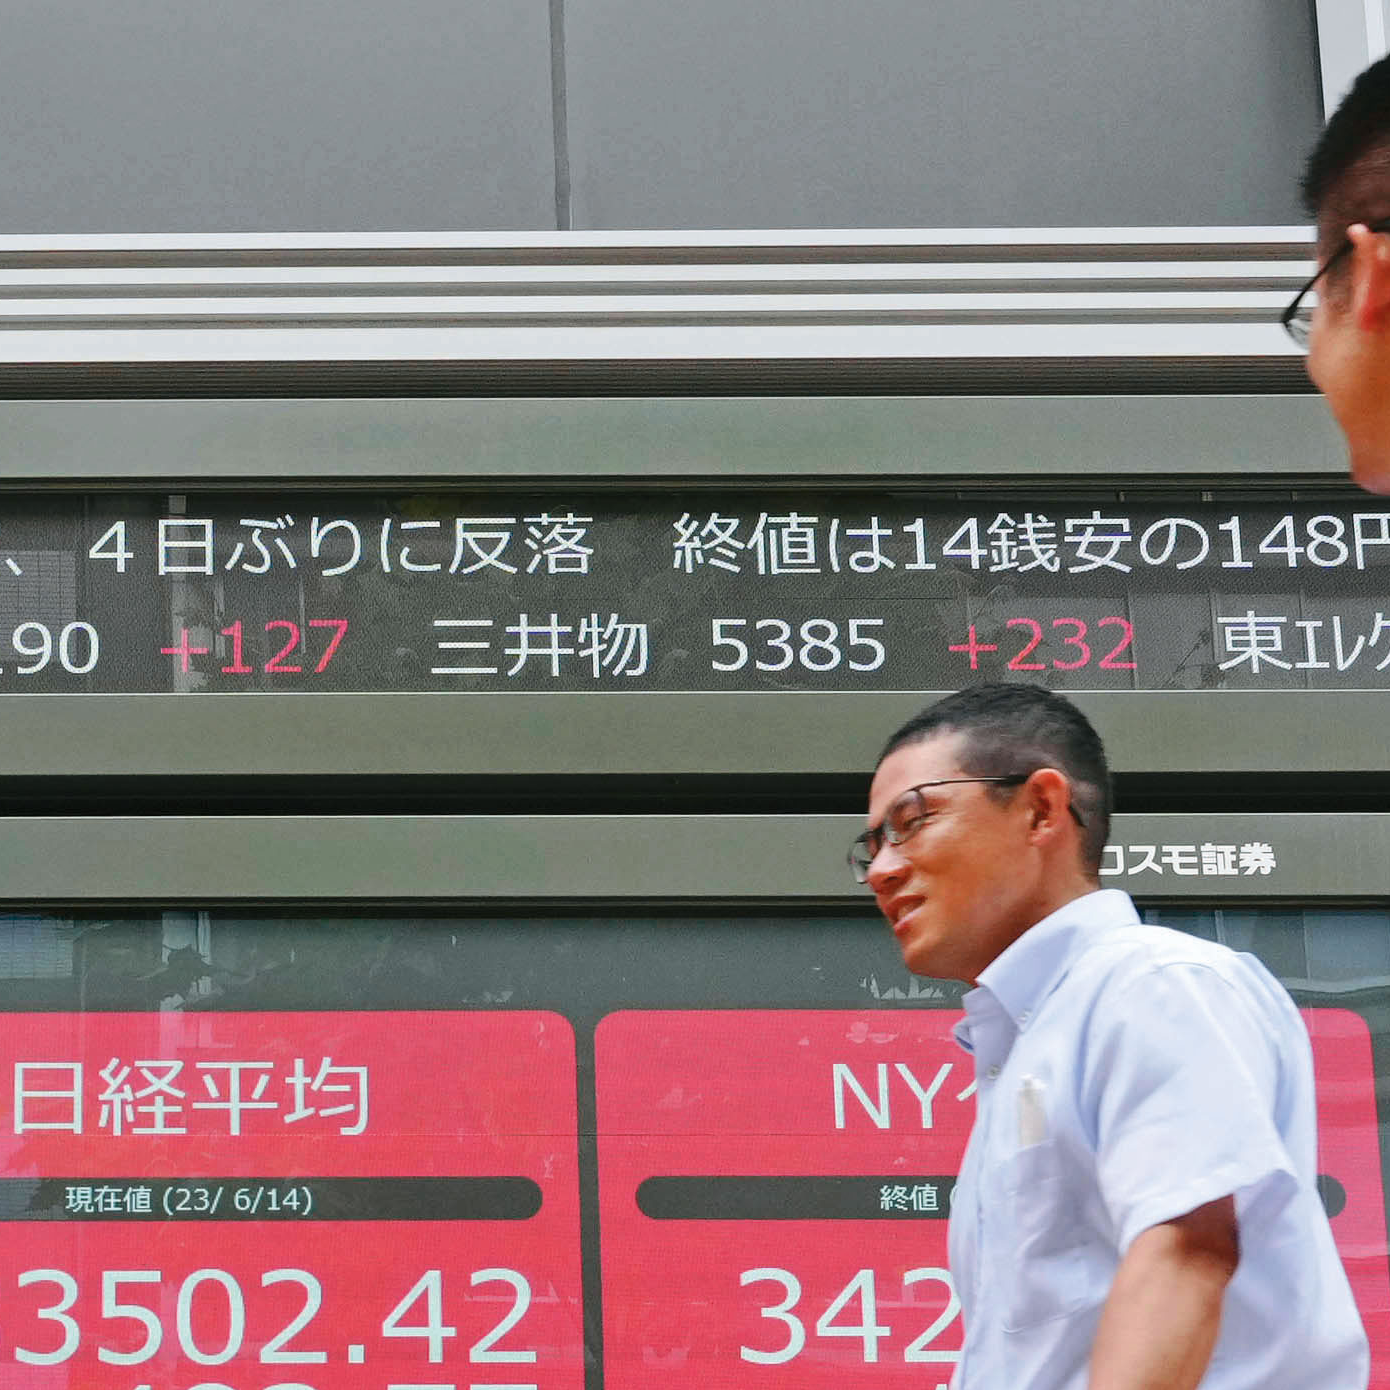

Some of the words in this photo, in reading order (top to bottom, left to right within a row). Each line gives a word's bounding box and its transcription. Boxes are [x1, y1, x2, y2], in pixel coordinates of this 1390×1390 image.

[160, 619, 348, 673] +127
[430, 612, 648, 679] 三井物
[711, 618, 885, 672] 5385
[948, 616, 1138, 671] +232
[13, 1056, 369, 1137] 日経平均
[832, 1063, 977, 1129] NY
[65, 1185, 153, 1213] 現在値
[879, 1183, 939, 1211] 終値
